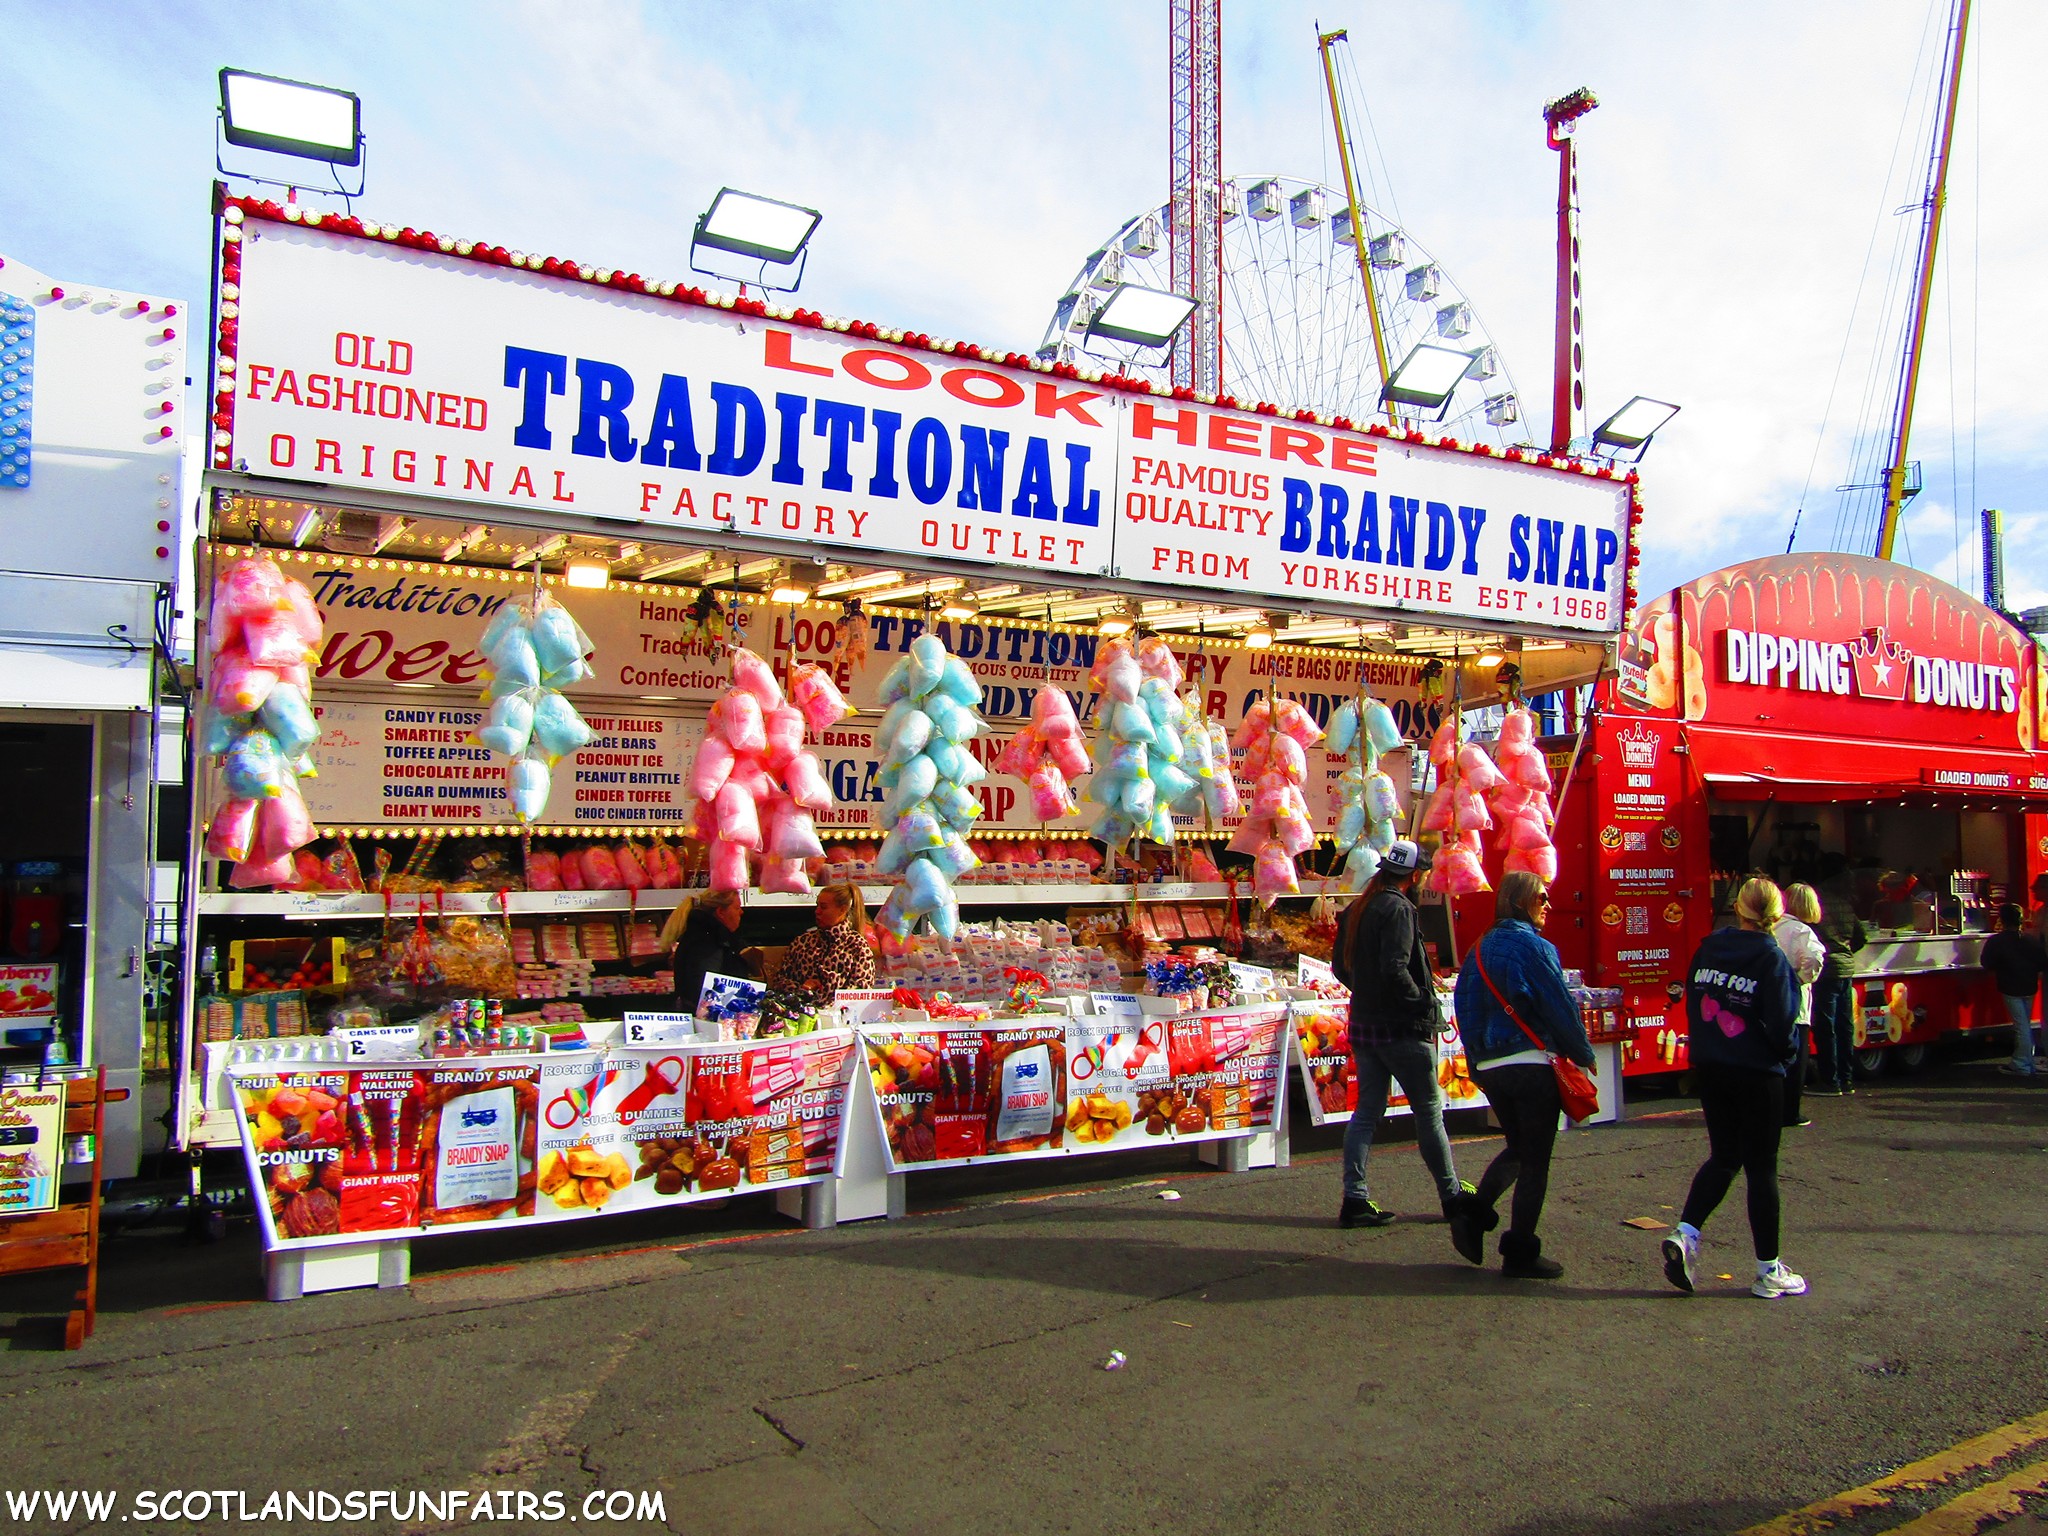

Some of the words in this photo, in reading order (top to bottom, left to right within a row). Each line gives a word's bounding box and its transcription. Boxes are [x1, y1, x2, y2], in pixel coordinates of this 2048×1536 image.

[334, 331, 412, 376] OLD
[247, 364, 487, 432] FASHIONED
[765, 329, 1104, 428] LOOK
[1132, 403, 1378, 476] HERE
[503, 345, 1100, 527] TRADITIONAL
[1131, 456, 1270, 501] FAMOUS
[270, 433, 575, 502] ORIGINAL
[640, 482, 869, 537] FACTORY
[921, 520, 1084, 565] OUTLET
[1126, 492, 1275, 536] QUALITY
[1279, 477, 1487, 576] BRANDY
[1507, 514, 1619, 592] SNAP
[1151, 547, 1250, 580] FROM
[1281, 562, 1453, 603] YORKSHIRE
[1478, 587, 1529, 611] EST
[1551, 596, 1607, 621] 1968
[773, 616, 838, 655] LOO
[871, 615, 1099, 669] TRADITION
[315, 630, 488, 684] wee
[1249, 653, 1294, 677] LARGE
[1296, 656, 1332, 681] BAGS
[1334, 660, 1353, 682] OF
[1354, 661, 1409, 686] FRESHLY
[1727, 628, 1851, 695] DIPPING
[1914, 656, 2016, 713] DONUTS
[384, 709, 435, 724] CANDY
[617, 720, 664, 733] JELLIES
[384, 727, 451, 743] SMARTIE
[823, 731, 872, 748] BARS
[621, 737, 657, 749] BARS
[1625, 740, 1653, 752] DIPPING
[384, 745, 435, 760] TOFFEE
[438, 747, 492, 761] APPLES
[575, 752, 640, 767] COCONUT
[642, 755, 664, 767] ICE
[1625, 751, 1653, 763] DONUTS
[383, 764, 470, 780] CHOCOLATE
[575, 770, 627, 784] PEANUT
[629, 772, 681, 785] BRITTLE
[1934, 770, 1972, 785] LOADED
[1973, 772, 2009, 787] DONUTS
[1628, 774, 1651, 787] MENU
[383, 784, 434, 799] SUGAR
[438, 785, 508, 800] DUMMIES
[575, 788, 625, 802] CINDER
[627, 790, 672, 803] TOFFEE
[1613, 793, 1638, 804] LOADED
[1639, 794, 1666, 805] DONUTS
[383, 803, 429, 818] GIANT
[431, 805, 482, 818] WHIPS
[575, 807, 605, 819] CHOC
[607, 807, 646, 820] CINDER
[648, 808, 684, 820] TOFFEE
[847, 809, 868, 823] FOR
[1609, 868, 1624, 880] MINI
[1625, 868, 1647, 880] SUGAR
[1648, 868, 1674, 879] DONUTS
[1617, 949, 1643, 961] DIPPING
[1644, 948, 1670, 960] SAUCES
[1727, 974, 1758, 994] FOX
[836, 992, 870, 1001] CHOCOLATE
[1113, 995, 1137, 1003] CABLES
[628, 1014, 655, 1022] GIANT
[656, 1014, 691, 1023] CABLES
[1172, 1018, 1201, 1028] TOFFEE
[380, 1028, 391, 1036] OF
[392, 1027, 415, 1035] POP
[630, 1025, 645, 1041] £
[996, 1031, 1034, 1042] BRANDY
[1035, 1029, 1061, 1040] SNAP
[1067, 1027, 1095, 1037] ROCK
[1096, 1025, 1136, 1035] DUMMIES
[1172, 1027, 1203, 1037] APPLES
[896, 1035, 937, 1044] JELLIES
[945, 1039, 983, 1048] WALKING
[950, 1047, 979, 1055] STICKS
[699, 1054, 743, 1066] TOFFEE
[1224, 1055, 1279, 1070] NOUGATS
[1307, 1055, 1347, 1067] CONUTS
[361, 1071, 414, 1081] SWEETIE
[433, 1070, 496, 1084] BRANDY
[497, 1068, 535, 1082] SNAP
[543, 1063, 583, 1077] ROCK
[697, 1065, 742, 1077] APPLES
[1096, 1068, 1128, 1078] SUGAR
[1129, 1064, 1169, 1075] DUMMIES
[232, 1075, 280, 1090] FRUIT
[283, 1075, 346, 1089] JELLIES
[1175, 1073, 1214, 1083] CHOCOLATE
[1182, 1080, 1206, 1090] APPLES
[1213, 1072, 1239, 1084] AND
[359, 1080, 415, 1091] WALKING
[1069, 1087, 1096, 1096] CINDER
[1097, 1085, 1122, 1094] TOFFEE
[1127, 1085, 1151, 1093] CINDER
[1152, 1082, 1175, 1091] TOFFEE
[364, 1090, 408, 1100] STICKS
[769, 1087, 843, 1112] NOUGATS
[1007, 1093, 1032, 1110] BRANDY
[1032, 1092, 1049, 1107] SNAP
[582, 1112, 623, 1127] SUGAR
[625, 1107, 685, 1121] DUMMIES
[755, 1113, 789, 1130] AND
[935, 1115, 959, 1123] GIANT
[961, 1113, 987, 1121] WHIPS
[628, 1122, 687, 1133] CHOCOLATE
[696, 1118, 753, 1132] CHOCOLATE
[620, 1132, 657, 1142] CINDER
[658, 1130, 694, 1140] TOFFEE
[708, 1127, 744, 1139] APPLES
[541, 1138, 579, 1150] CINDER
[581, 1133, 615, 1146] TOFFEE
[257, 1148, 340, 1167] CONUTS
[447, 1146, 484, 1166] BRANDY
[485, 1143, 510, 1162] SNAP
[342, 1176, 380, 1187] GIANT
[382, 1173, 420, 1184] WHIPS
